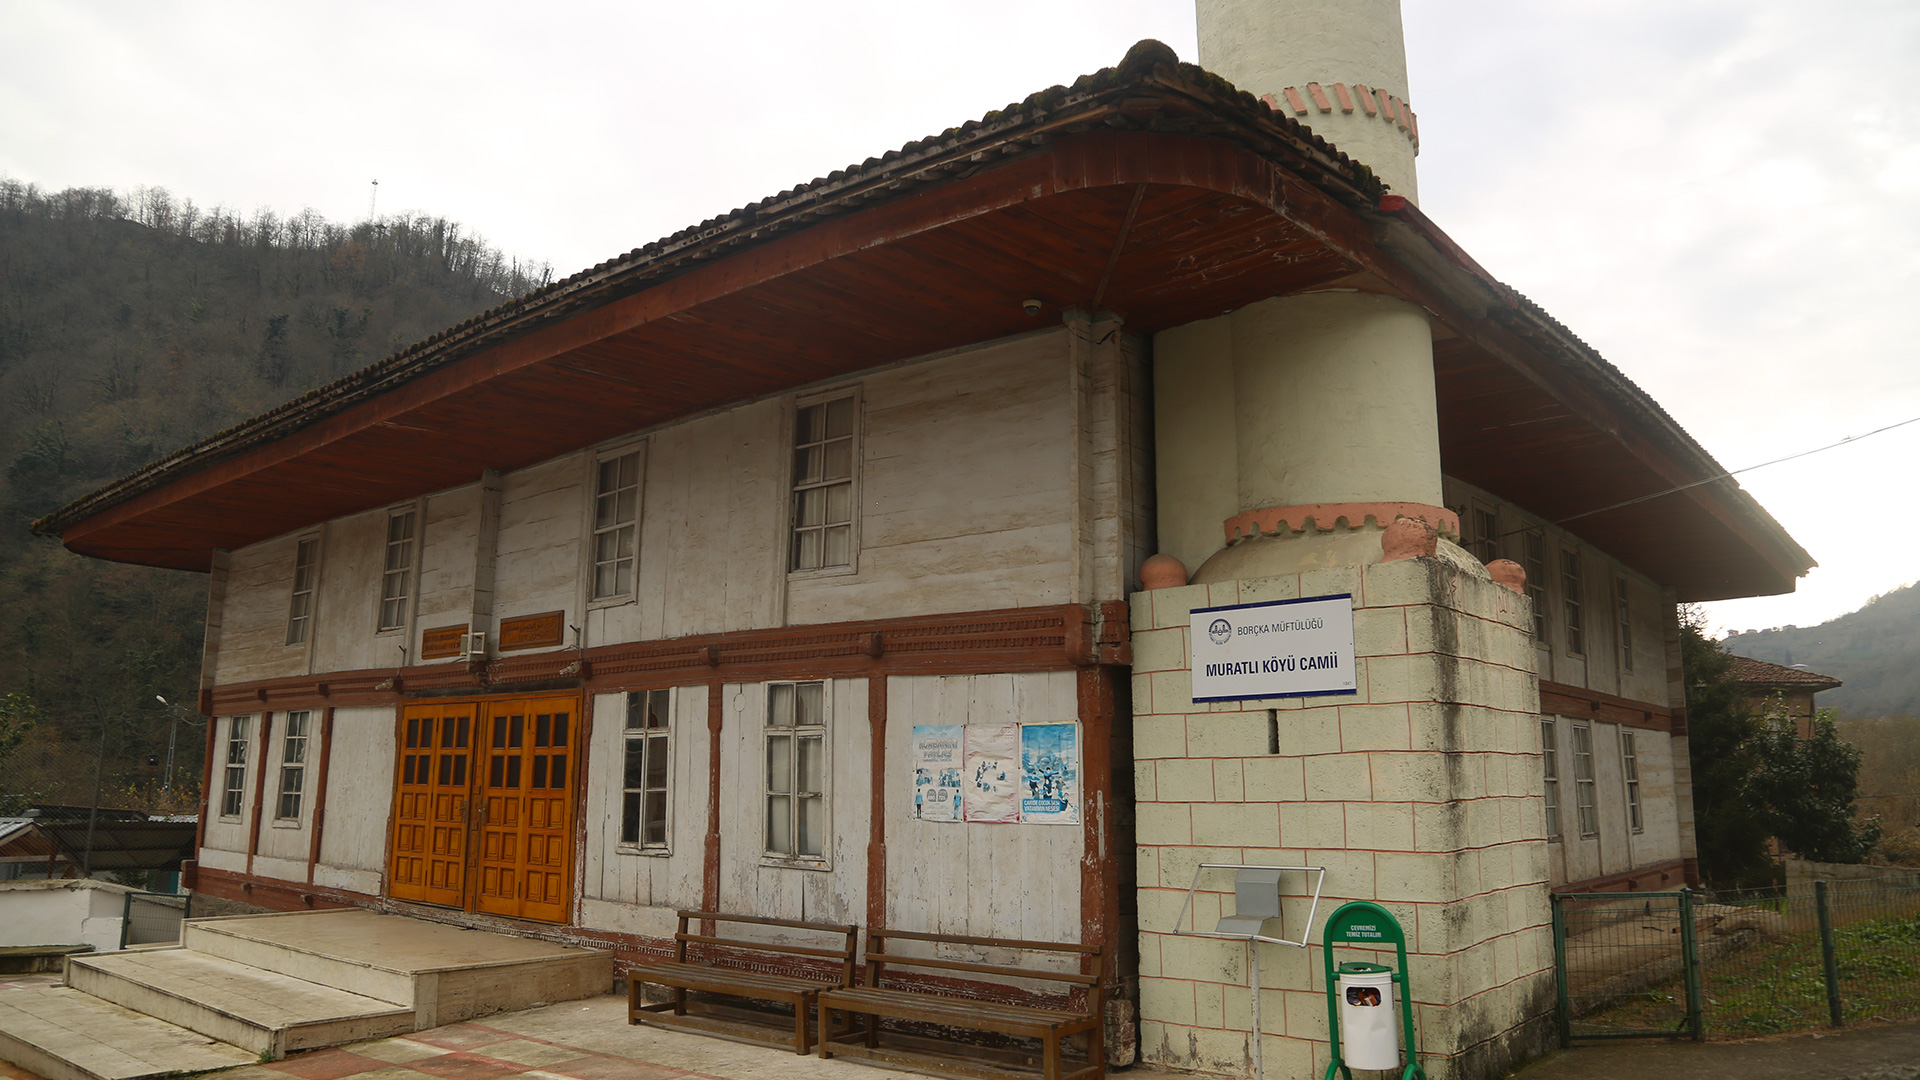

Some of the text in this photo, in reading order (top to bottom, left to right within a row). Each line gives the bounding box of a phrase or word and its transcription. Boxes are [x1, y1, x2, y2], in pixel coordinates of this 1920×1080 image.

[1238, 618, 1323, 636] BORÇKA MÜFTÜLÜĞÜ
[1206, 652, 1338, 677] MURATLI KÖYÜ CAMİİ
